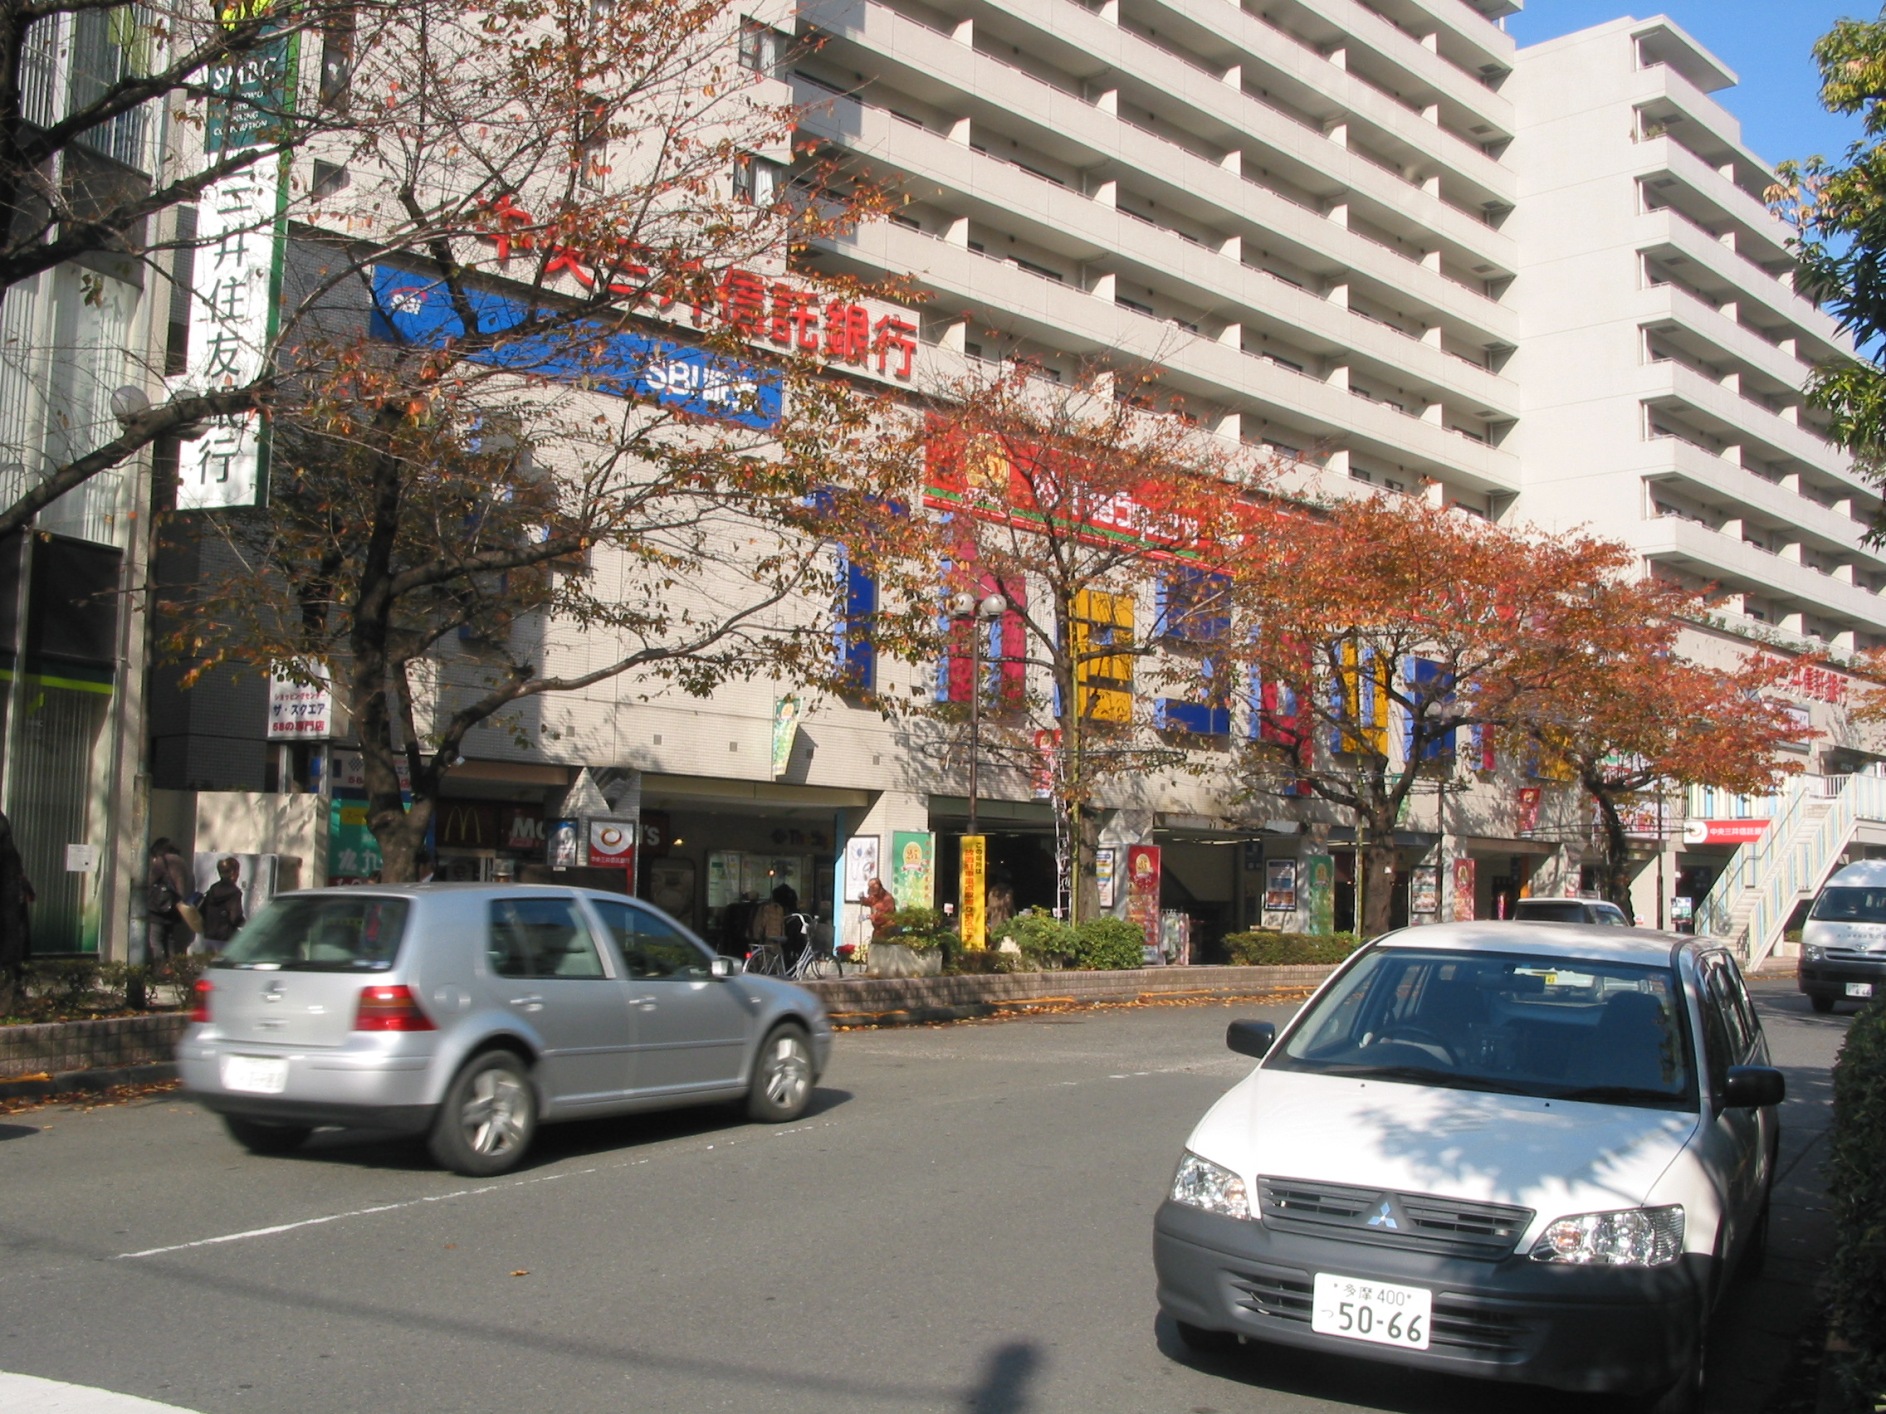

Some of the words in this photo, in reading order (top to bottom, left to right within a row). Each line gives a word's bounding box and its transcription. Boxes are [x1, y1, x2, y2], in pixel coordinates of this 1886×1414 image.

[198, 169, 255, 485] 三井住友行
[272, 702, 326, 716] ザ・スクエア
[1338, 1301, 1422, 1342] 50-66
